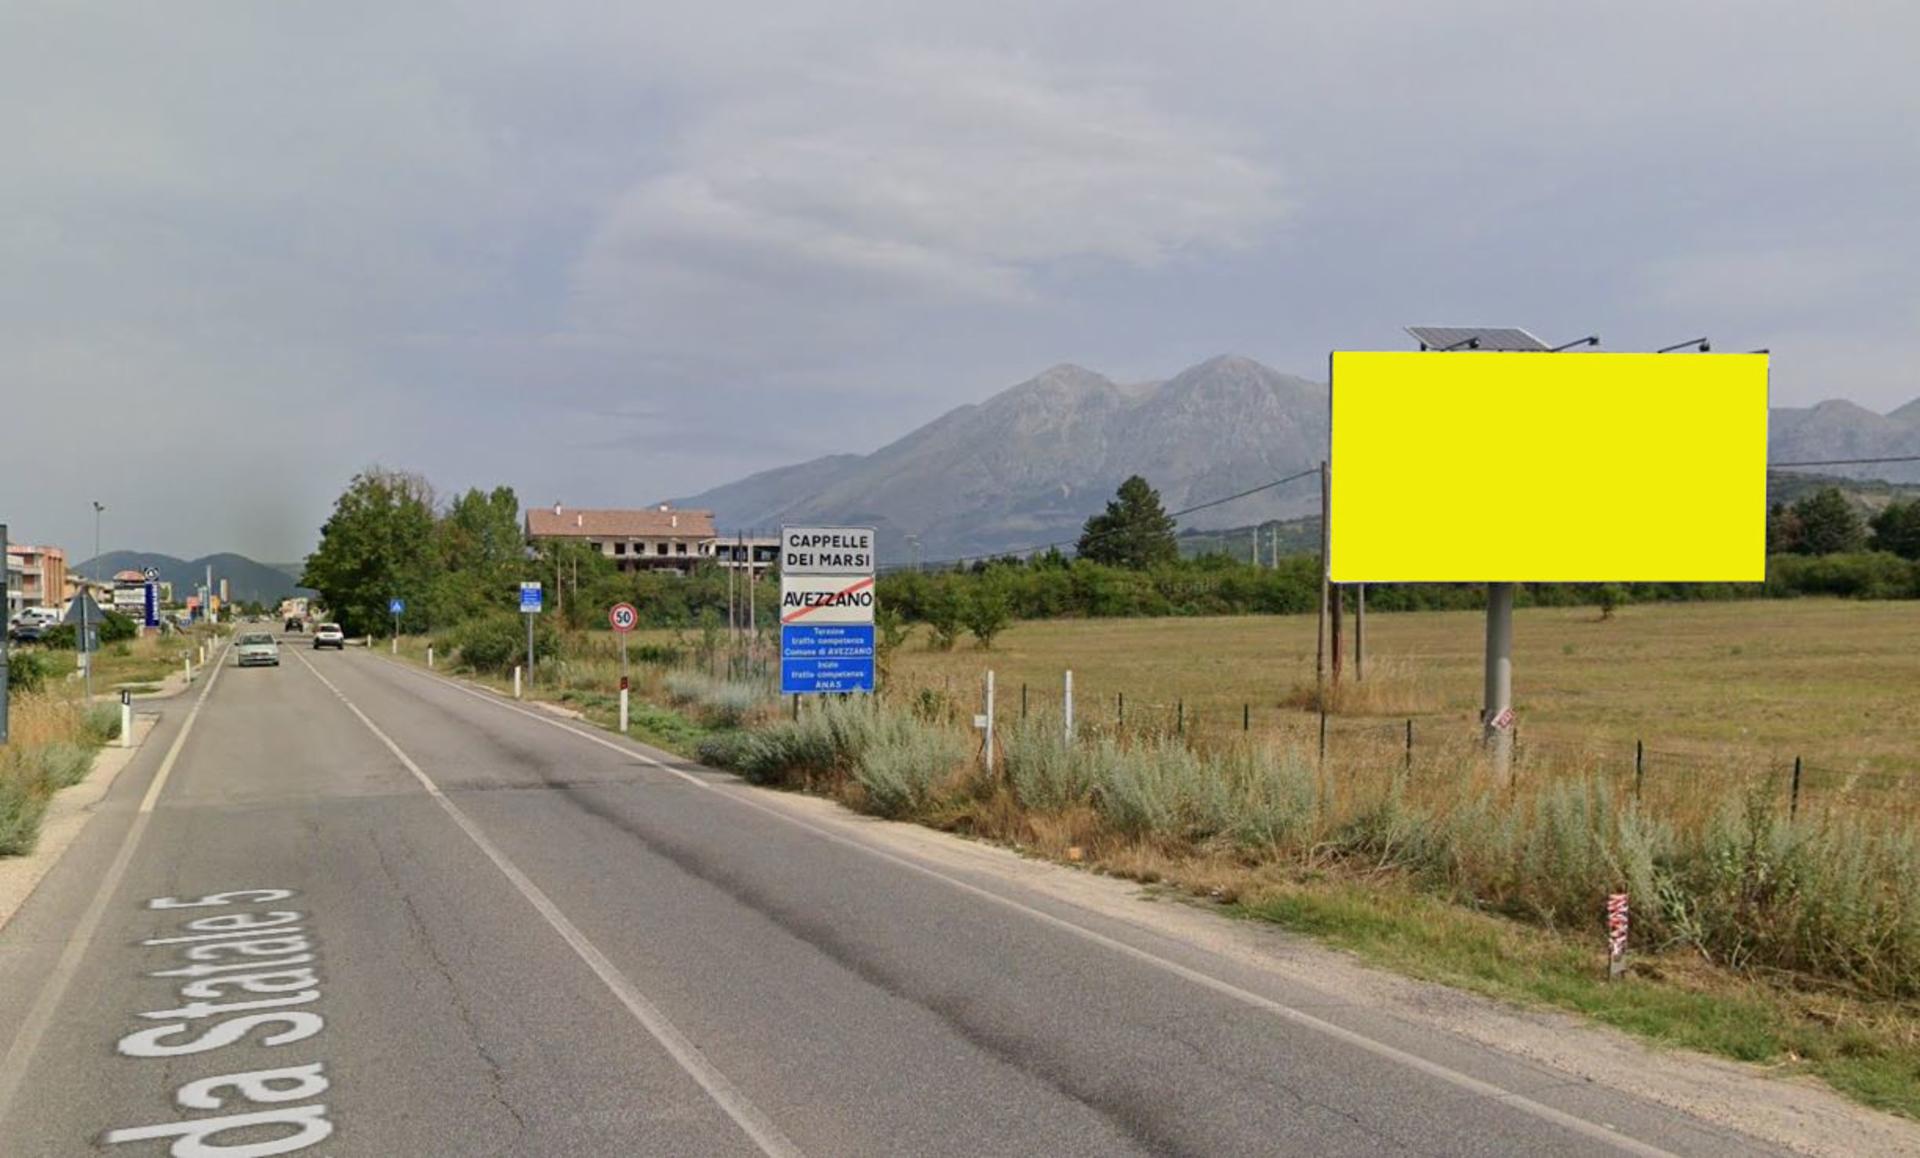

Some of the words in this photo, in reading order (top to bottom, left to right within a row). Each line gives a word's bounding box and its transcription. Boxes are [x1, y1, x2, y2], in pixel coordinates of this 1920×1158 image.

[789, 534, 869, 549] CAPPELLE
[787, 553, 814, 566] DEI
[819, 553, 870, 567] MARSI
[783, 590, 873, 607] AVEZZANO
[616, 611, 631, 624] 50
[827, 647, 873, 656] AVEZZANO
[815, 681, 842, 689] ANAS
